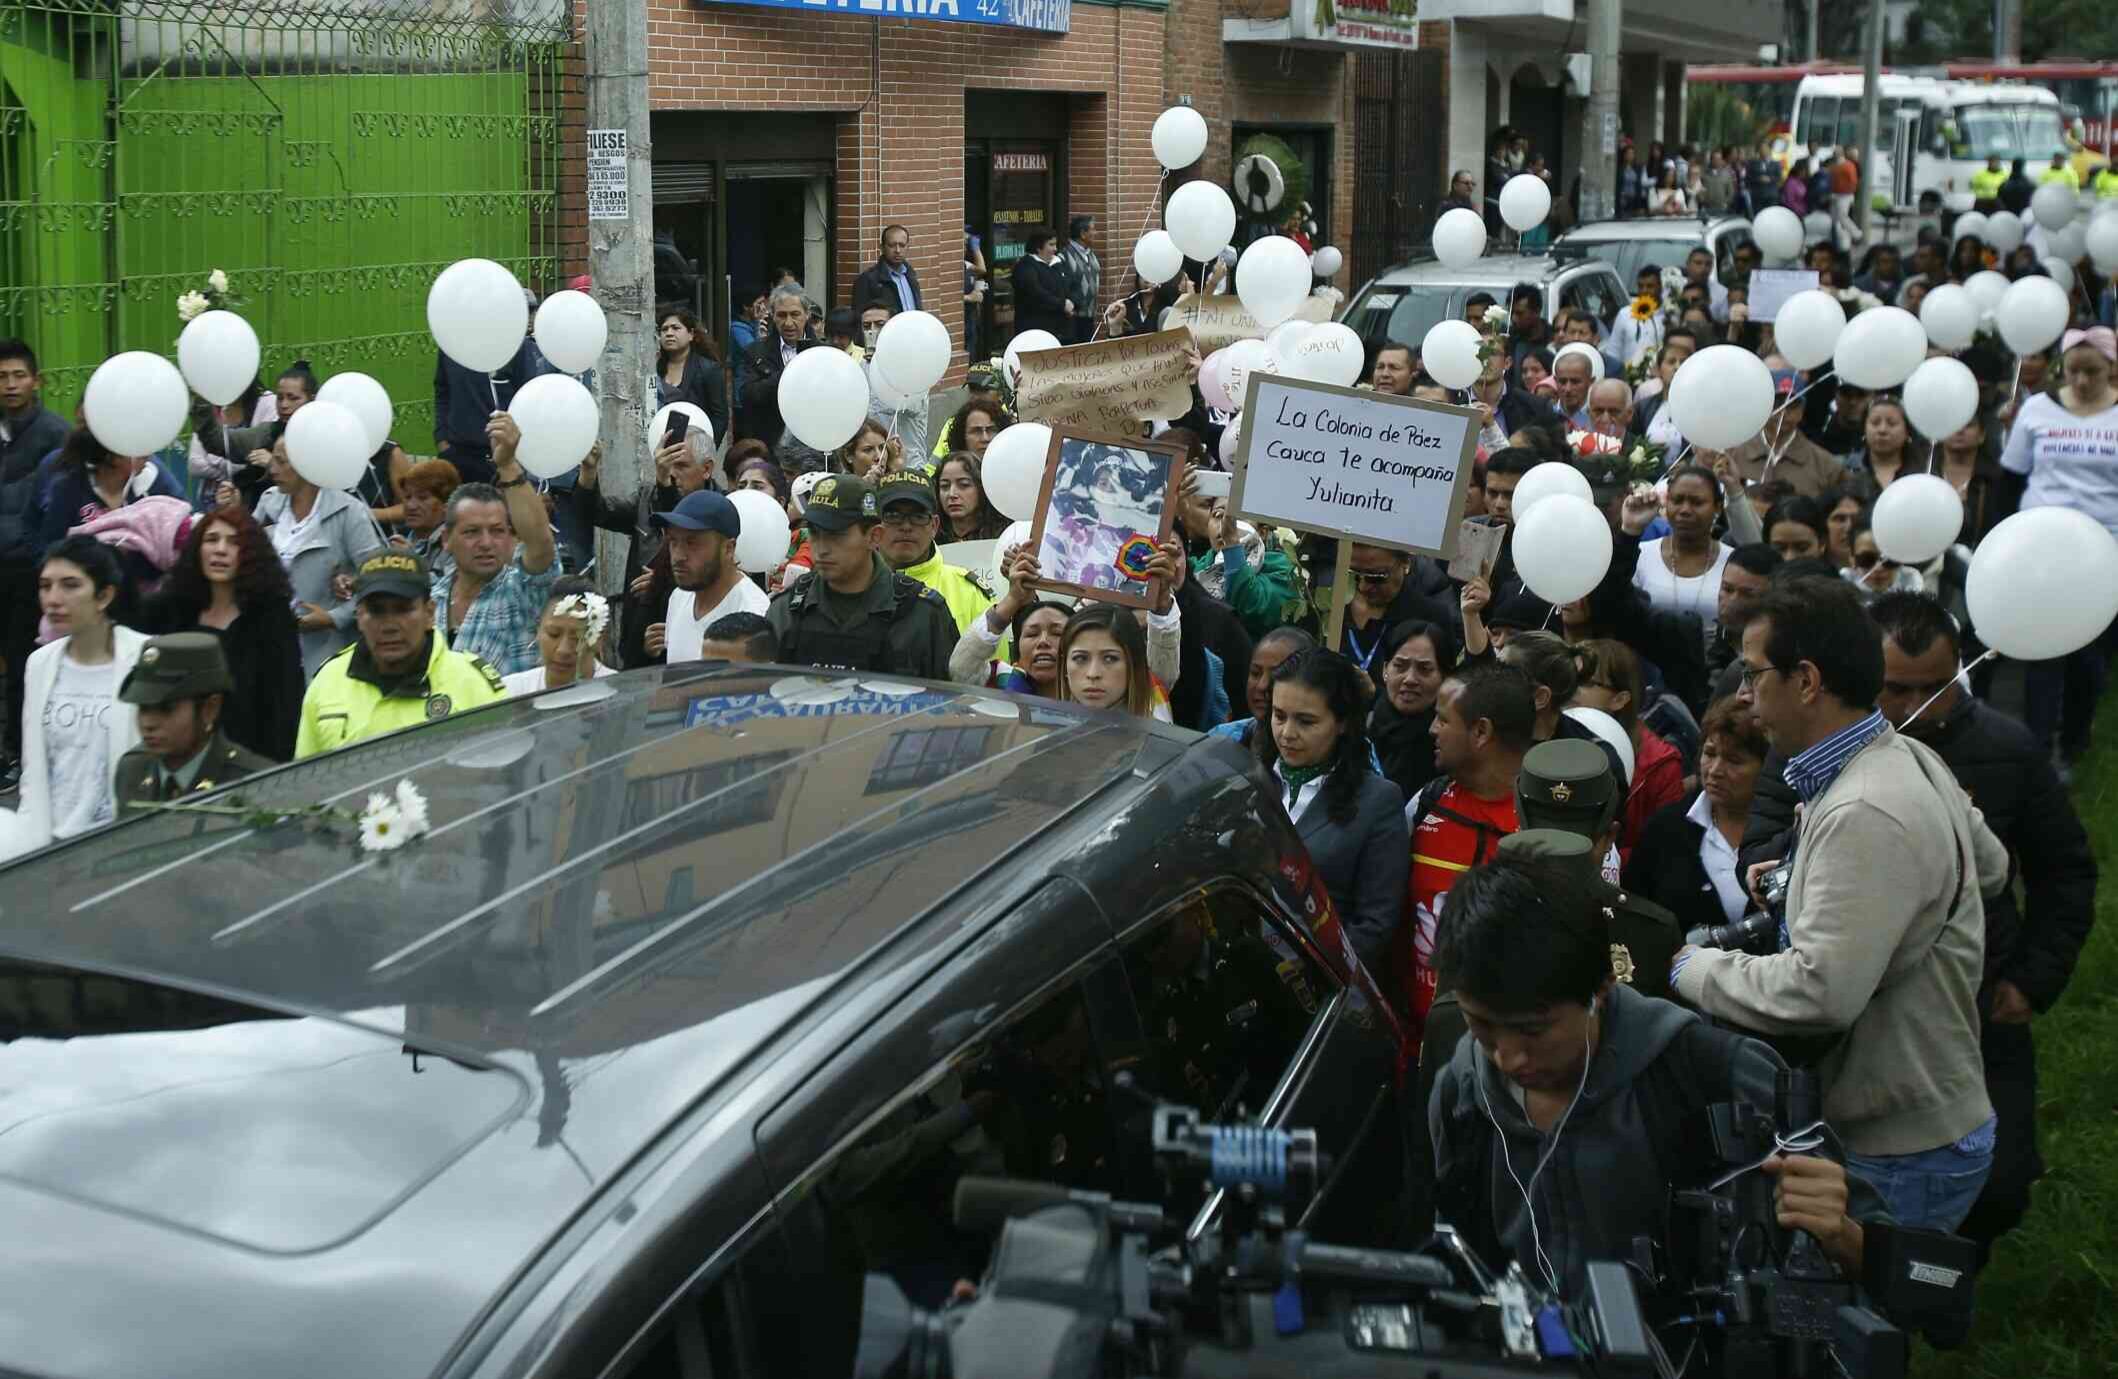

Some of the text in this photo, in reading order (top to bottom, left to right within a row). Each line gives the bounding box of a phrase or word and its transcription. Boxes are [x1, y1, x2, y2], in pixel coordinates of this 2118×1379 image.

[1276, 396, 1442, 450] La Colonia de Páez
[880, 471, 929, 487] POLICIA
[1266, 440, 1326, 464] Cauca
[1371, 456, 1455, 489] acompaña
[1306, 476, 1395, 513] Yulianita
